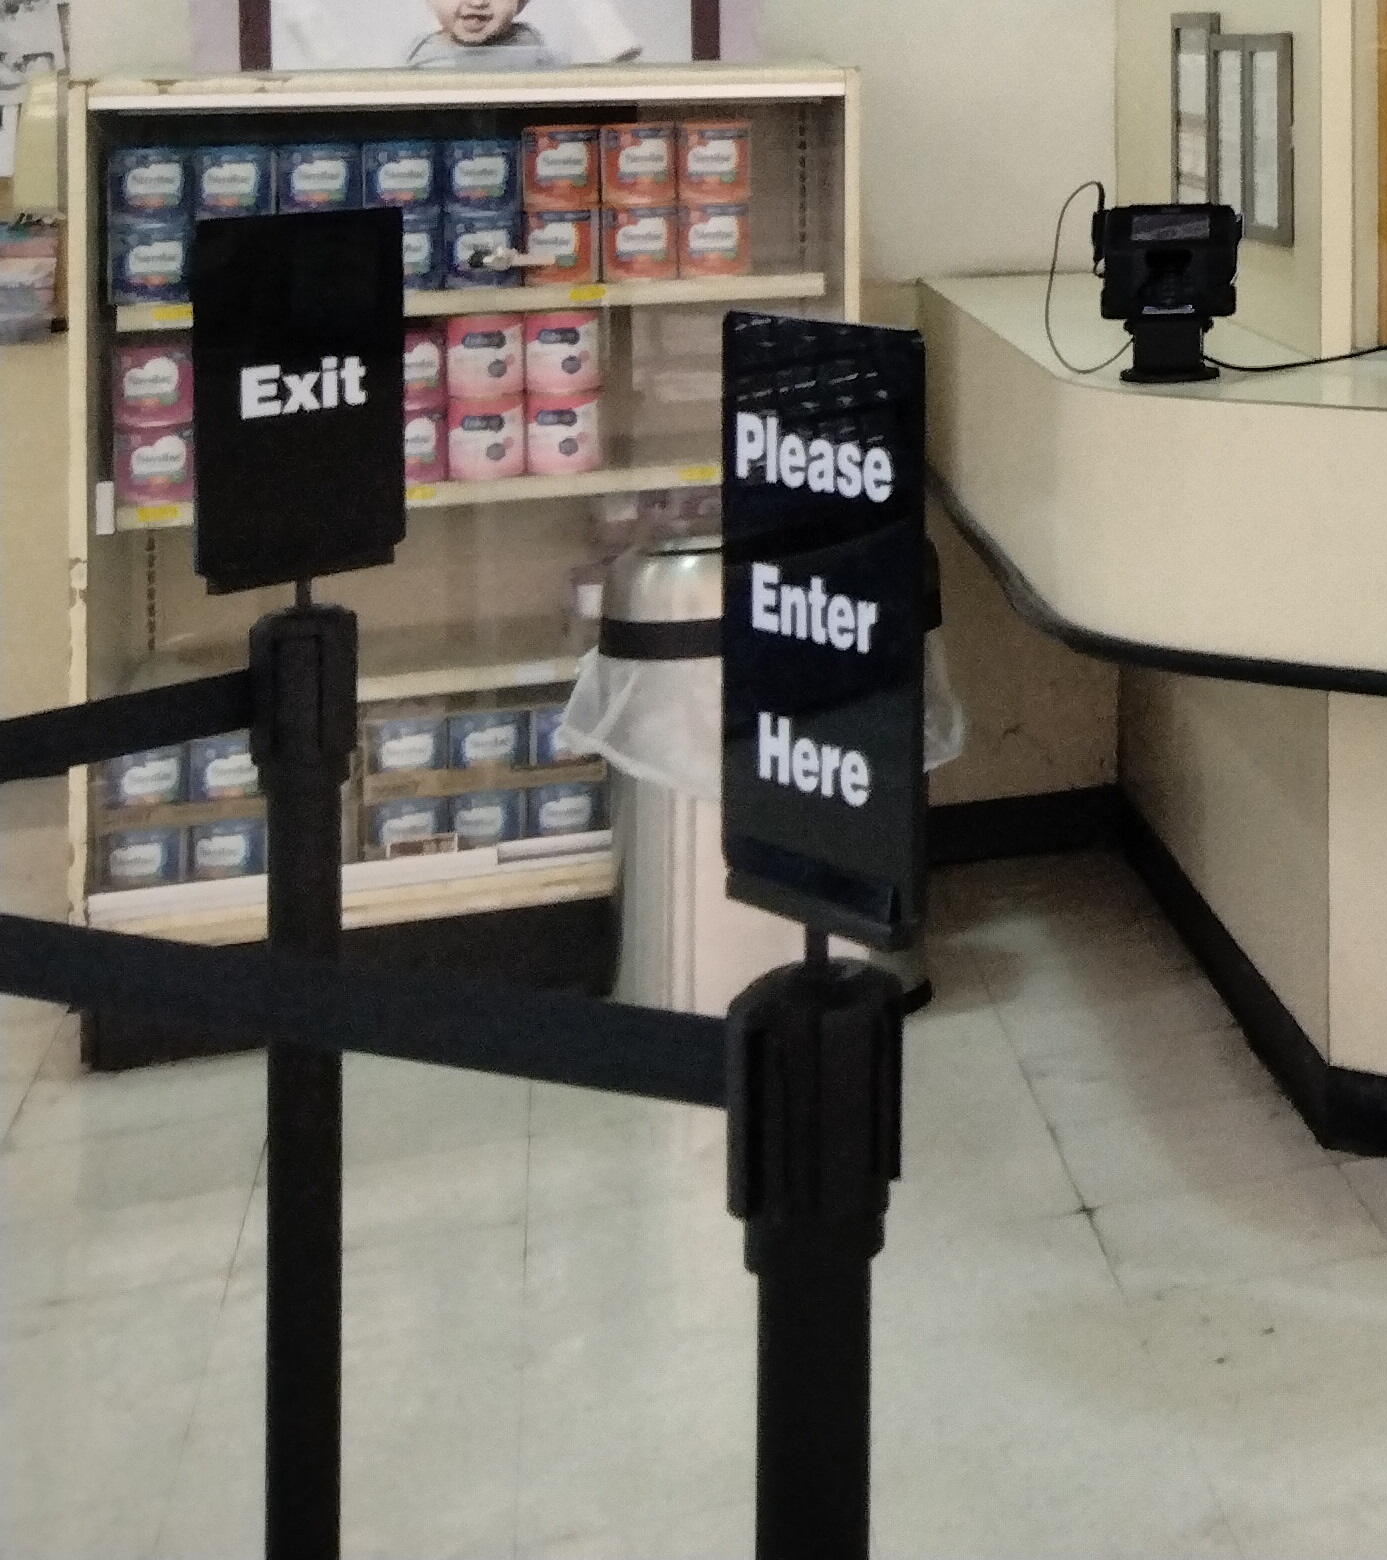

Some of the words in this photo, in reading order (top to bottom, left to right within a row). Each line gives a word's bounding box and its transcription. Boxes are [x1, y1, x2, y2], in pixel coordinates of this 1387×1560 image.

[240, 356, 368, 420] Exit
[735, 411, 894, 502] Please
[750, 563, 879, 654] Enter
[758, 711, 871, 806] Here
